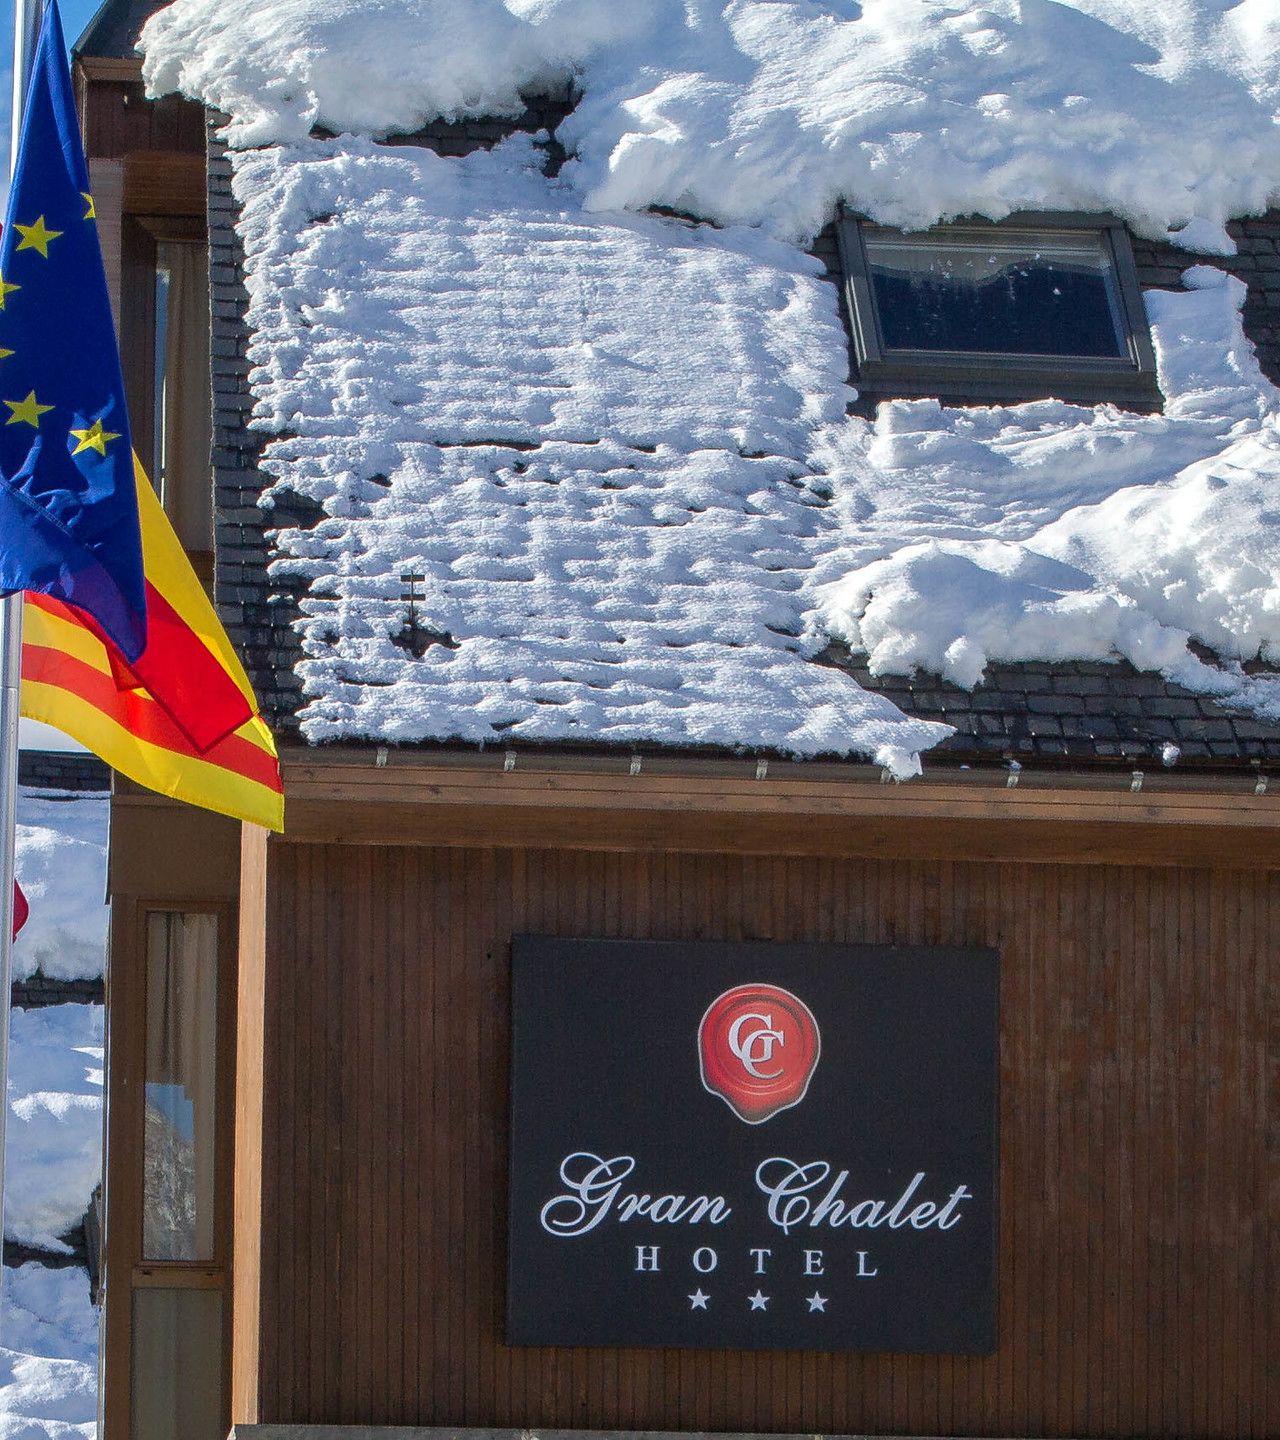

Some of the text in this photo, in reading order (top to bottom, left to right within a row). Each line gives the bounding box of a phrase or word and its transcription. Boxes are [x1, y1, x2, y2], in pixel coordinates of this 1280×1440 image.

[540, 1151, 973, 1238] Gran Chalet
[634, 1245, 878, 1277] HOTEL
